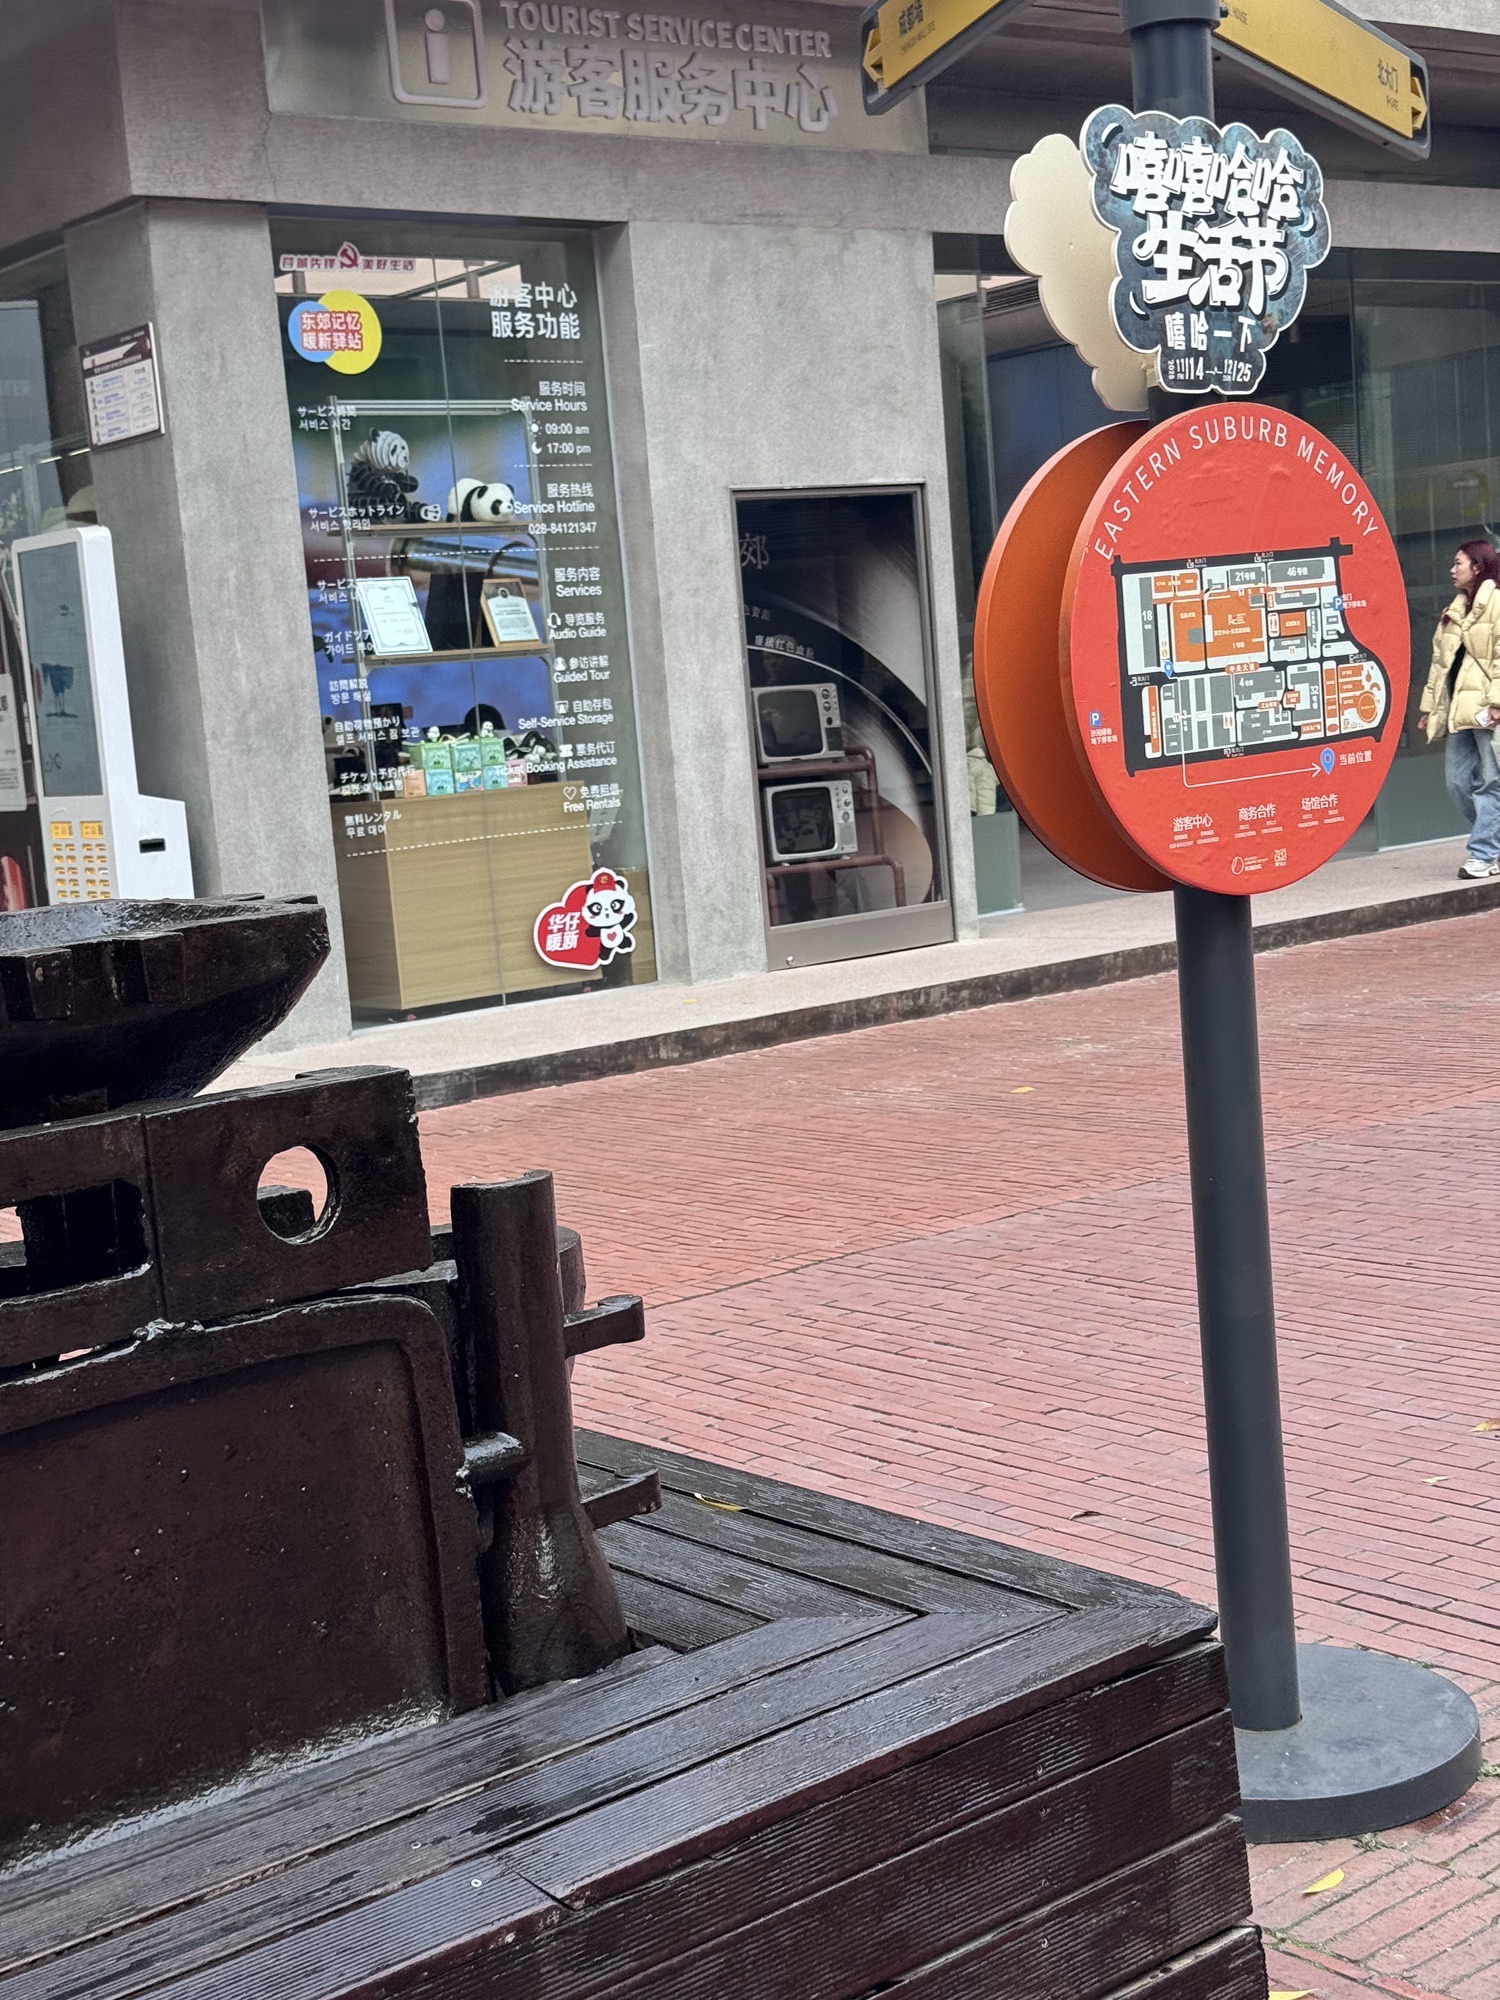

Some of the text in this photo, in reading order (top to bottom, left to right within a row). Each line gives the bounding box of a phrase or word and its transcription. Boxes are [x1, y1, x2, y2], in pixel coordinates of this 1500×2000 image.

[500, 1, 832, 58] TOURIST SERVICE CENTER
[504, 36, 839, 132] 游客服务中心
[1110, 131, 1304, 220] 嘻嘻哈哈
[1132, 210, 1290, 315] 生活节
[301, 312, 361, 331] 东郊记忆
[491, 311, 581, 339] 服务功能
[1165, 311, 1256, 352] 嘻哈一下
[302, 332, 362, 350] 暖新驿站
[539, 381, 586, 396] 服务时间
[511, 398, 588, 412] Service Hours
[299, 419, 329, 431] 서비스
[545, 423, 590, 434] 09:00 am
[547, 443, 591, 455] 17:00 pm
[547, 483, 594, 498] 服务热线
[1095, 416, 1379, 560] EASTERN SUBURB MEMORY
[308, 505, 405, 519] サービスホットライン
[514, 500, 595, 514] Service Hotline
[310, 520, 340, 532] 서비스
[528, 522, 597, 534] 028-84121347
[554, 567, 600, 582] 服务内容
[319, 592, 348, 604] 서비스
[556, 584, 603, 597] Services
[1142, 611, 1153, 622] 18
[325, 629, 371, 642] ガイドツア
[549, 626, 607, 640] Audio Guide
[325, 643, 354, 655] 가이드
[554, 669, 611, 683] Guided Tour
[1310, 685, 1319, 695] 32
[573, 698, 613, 713] 自助存包
[518, 713, 613, 729] Self-Service Storage
[576, 741, 616, 756] 票务代订
[495, 756, 617, 776] Ticket Booking Assistance
[1340, 751, 1372, 766] 当前位置
[563, 797, 621, 813] Free Rentals
[1301, 793, 1338, 811] 场馆合作
[1238, 803, 1276, 821] 商务合作
[1173, 813, 1213, 832] 游客中心
[547, 911, 581, 933] 华仔
[546, 930, 579, 952] 暖新
